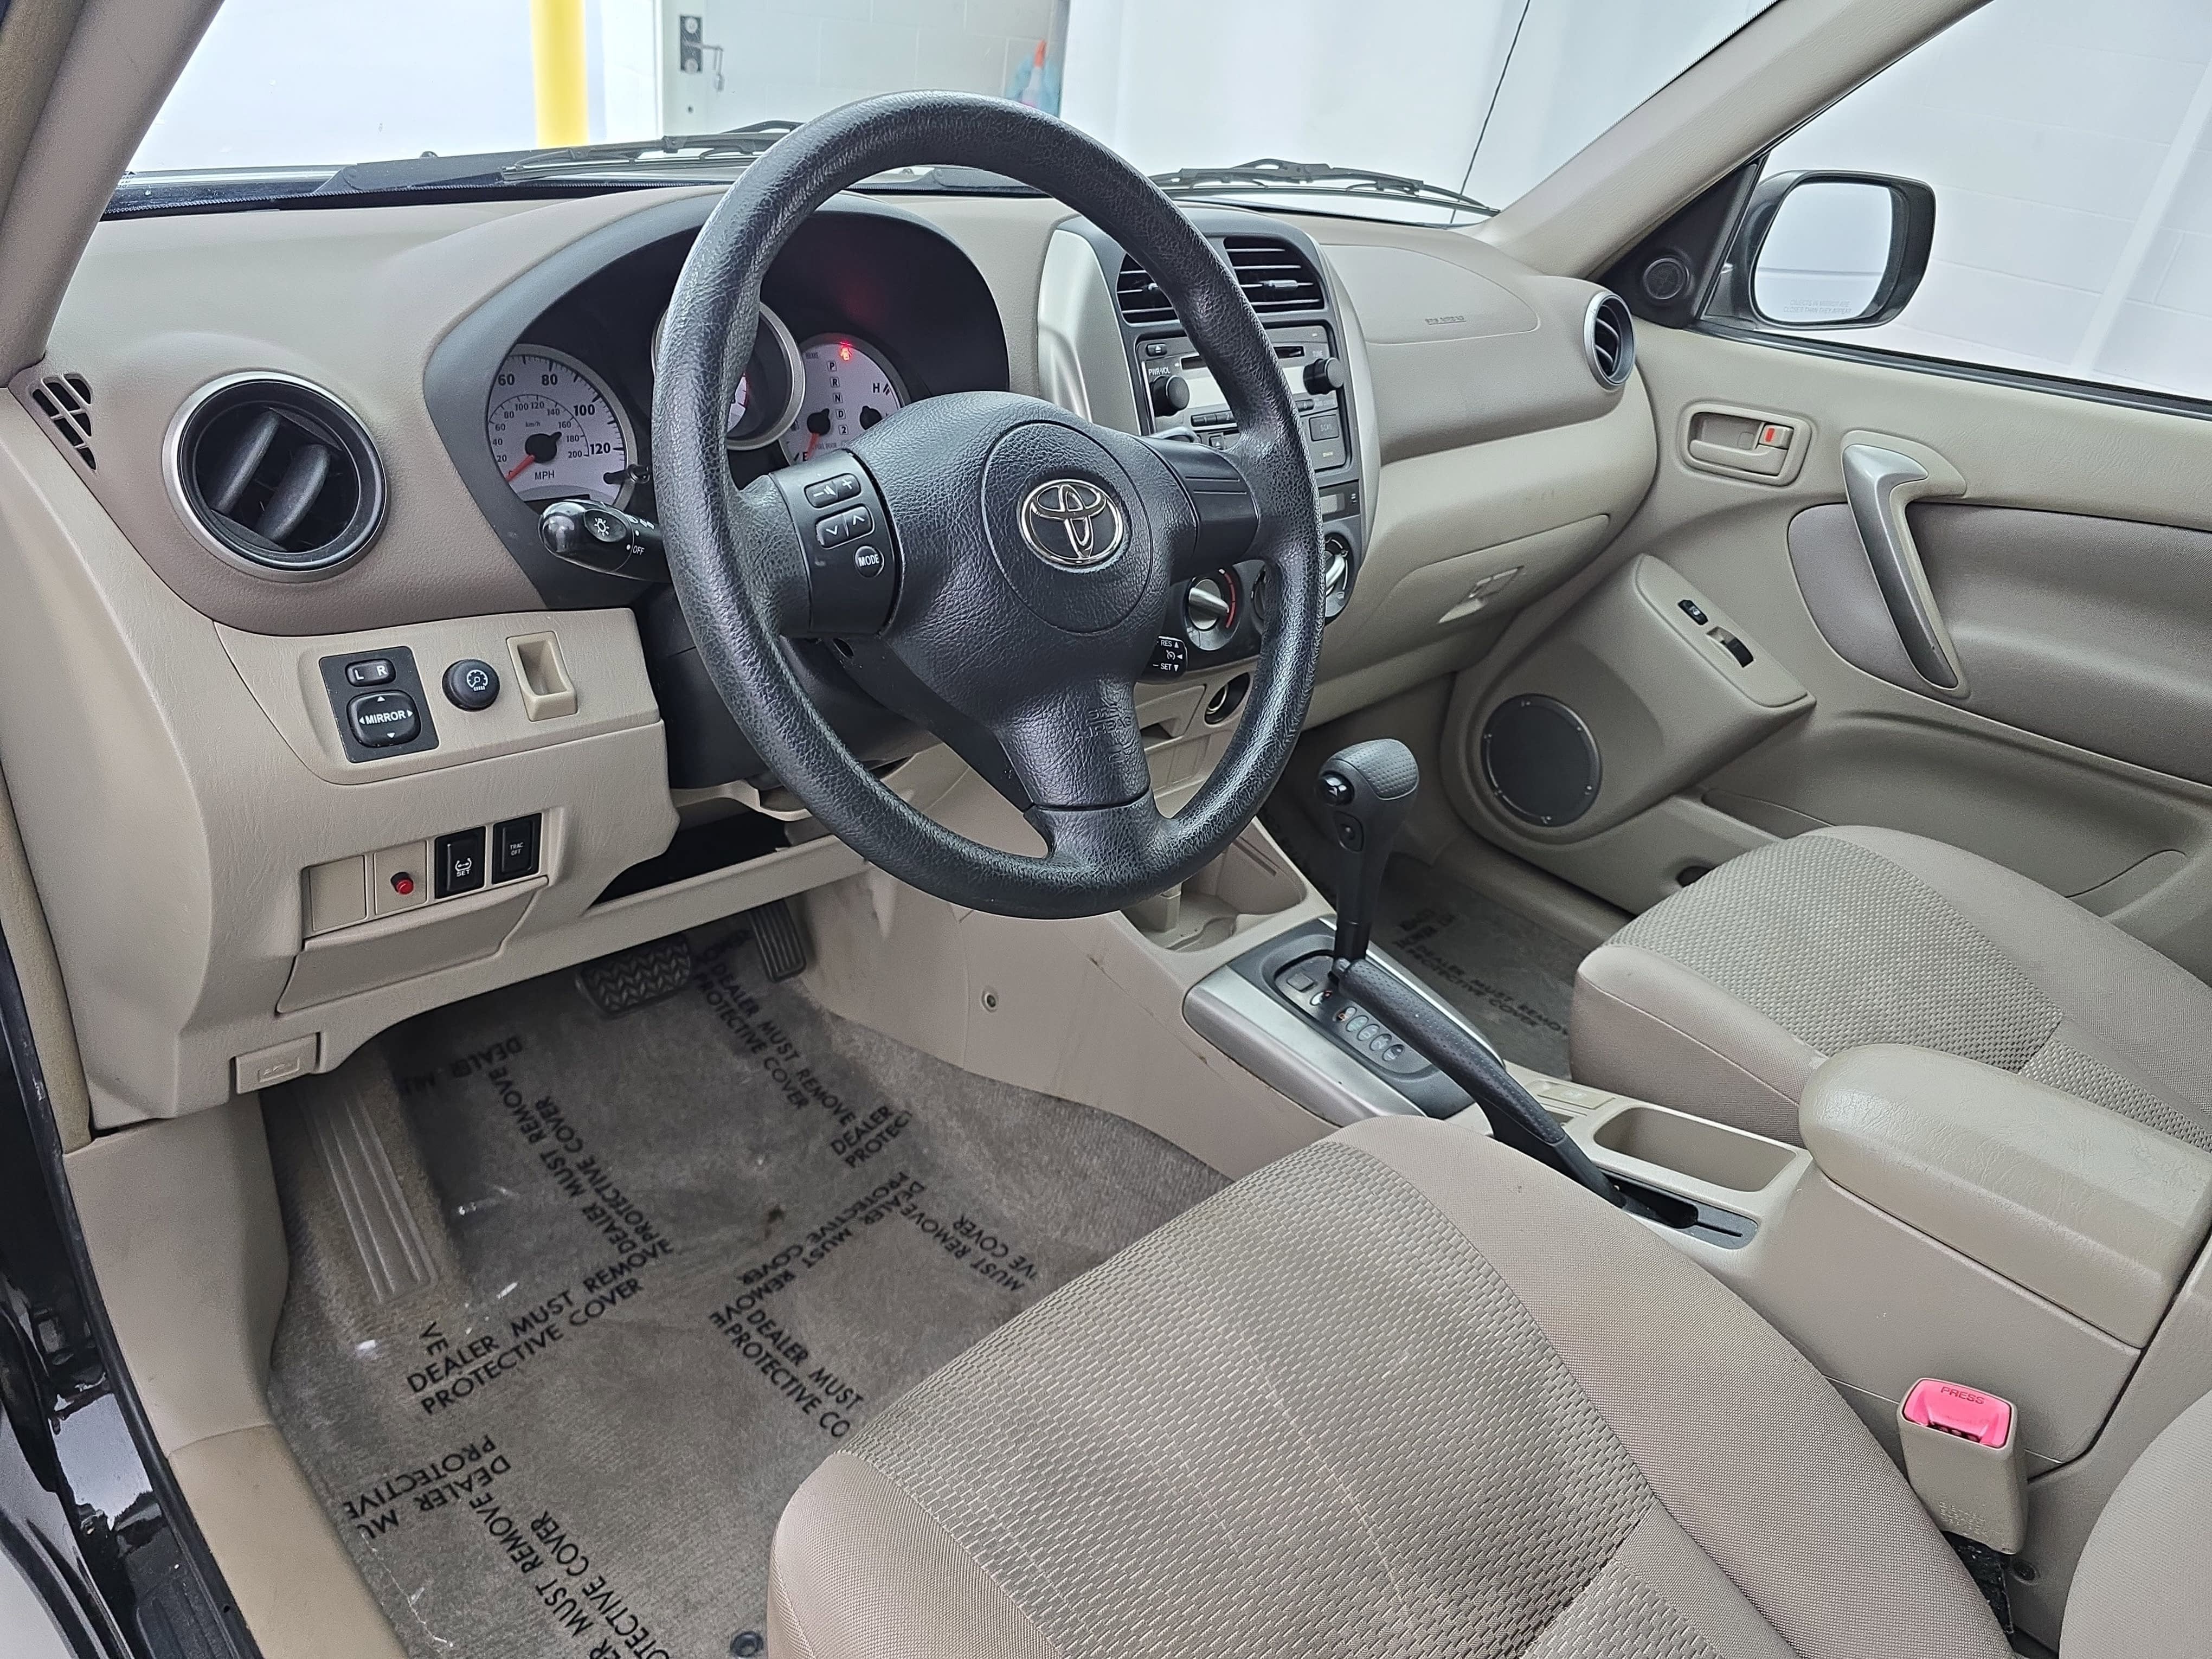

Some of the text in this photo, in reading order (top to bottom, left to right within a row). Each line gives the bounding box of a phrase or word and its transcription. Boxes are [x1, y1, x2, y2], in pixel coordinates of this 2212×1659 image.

[498, 374, 516, 386] 60
[542, 374, 558, 386] 80
[872, 383, 880, 393] H
[504, 411, 515, 419] 80
[515, 403, 529, 411] 100
[531, 402, 544, 410] 120
[574, 404, 595, 416] 100
[590, 442, 611, 455] 120
[802, 452, 808, 461] E
[535, 470, 555, 480] MPH
[633, 545, 645, 556] OFF
[858, 553, 880, 568] MODE
[354, 665, 388, 680] L R
[1160, 663, 1173, 671] SET
[365, 710, 407, 725] MIRROR
[510, 842, 524, 850] TRAC
[456, 868, 471, 877] SET
[449, 1034, 522, 1078] DEALER
[759, 1020, 801, 1062] MUST
[797, 1068, 856, 1127] REMOVE
[763, 1057, 809, 1109] COVER
[831, 1106, 894, 1155] DEALER
[489, 1066, 639, 1255] DEALER MUST REMOVE
[535, 1096, 658, 1242] PROTECTIVE COVER
[737, 1172, 910, 1285] PROTECTIVE COVER
[801, 1227, 853, 1269] MUST
[900, 1203, 1025, 1291] MUST REMOVE
[953, 1215, 1009, 1258] COVER
[407, 1239, 674, 1393] DEALER MUST REMOVE
[709, 1270, 796, 1328] REMOVE
[420, 1321, 448, 1356] VE
[421, 1277, 644, 1414] PROTECTIVE COVER
[747, 1309, 864, 1410] DEALER MUST
[724, 1323, 851, 1437] PROTECTIVE CO
[1940, 1386, 1985, 1405] PRESS
[343, 1435, 496, 1519] PROTECTIVE
[413, 1455, 512, 1512] DEALER
[468, 1493, 545, 1573] REMOVE
[530, 1510, 589, 1577] COVER
[536, 1578, 593, 1637] MUST
